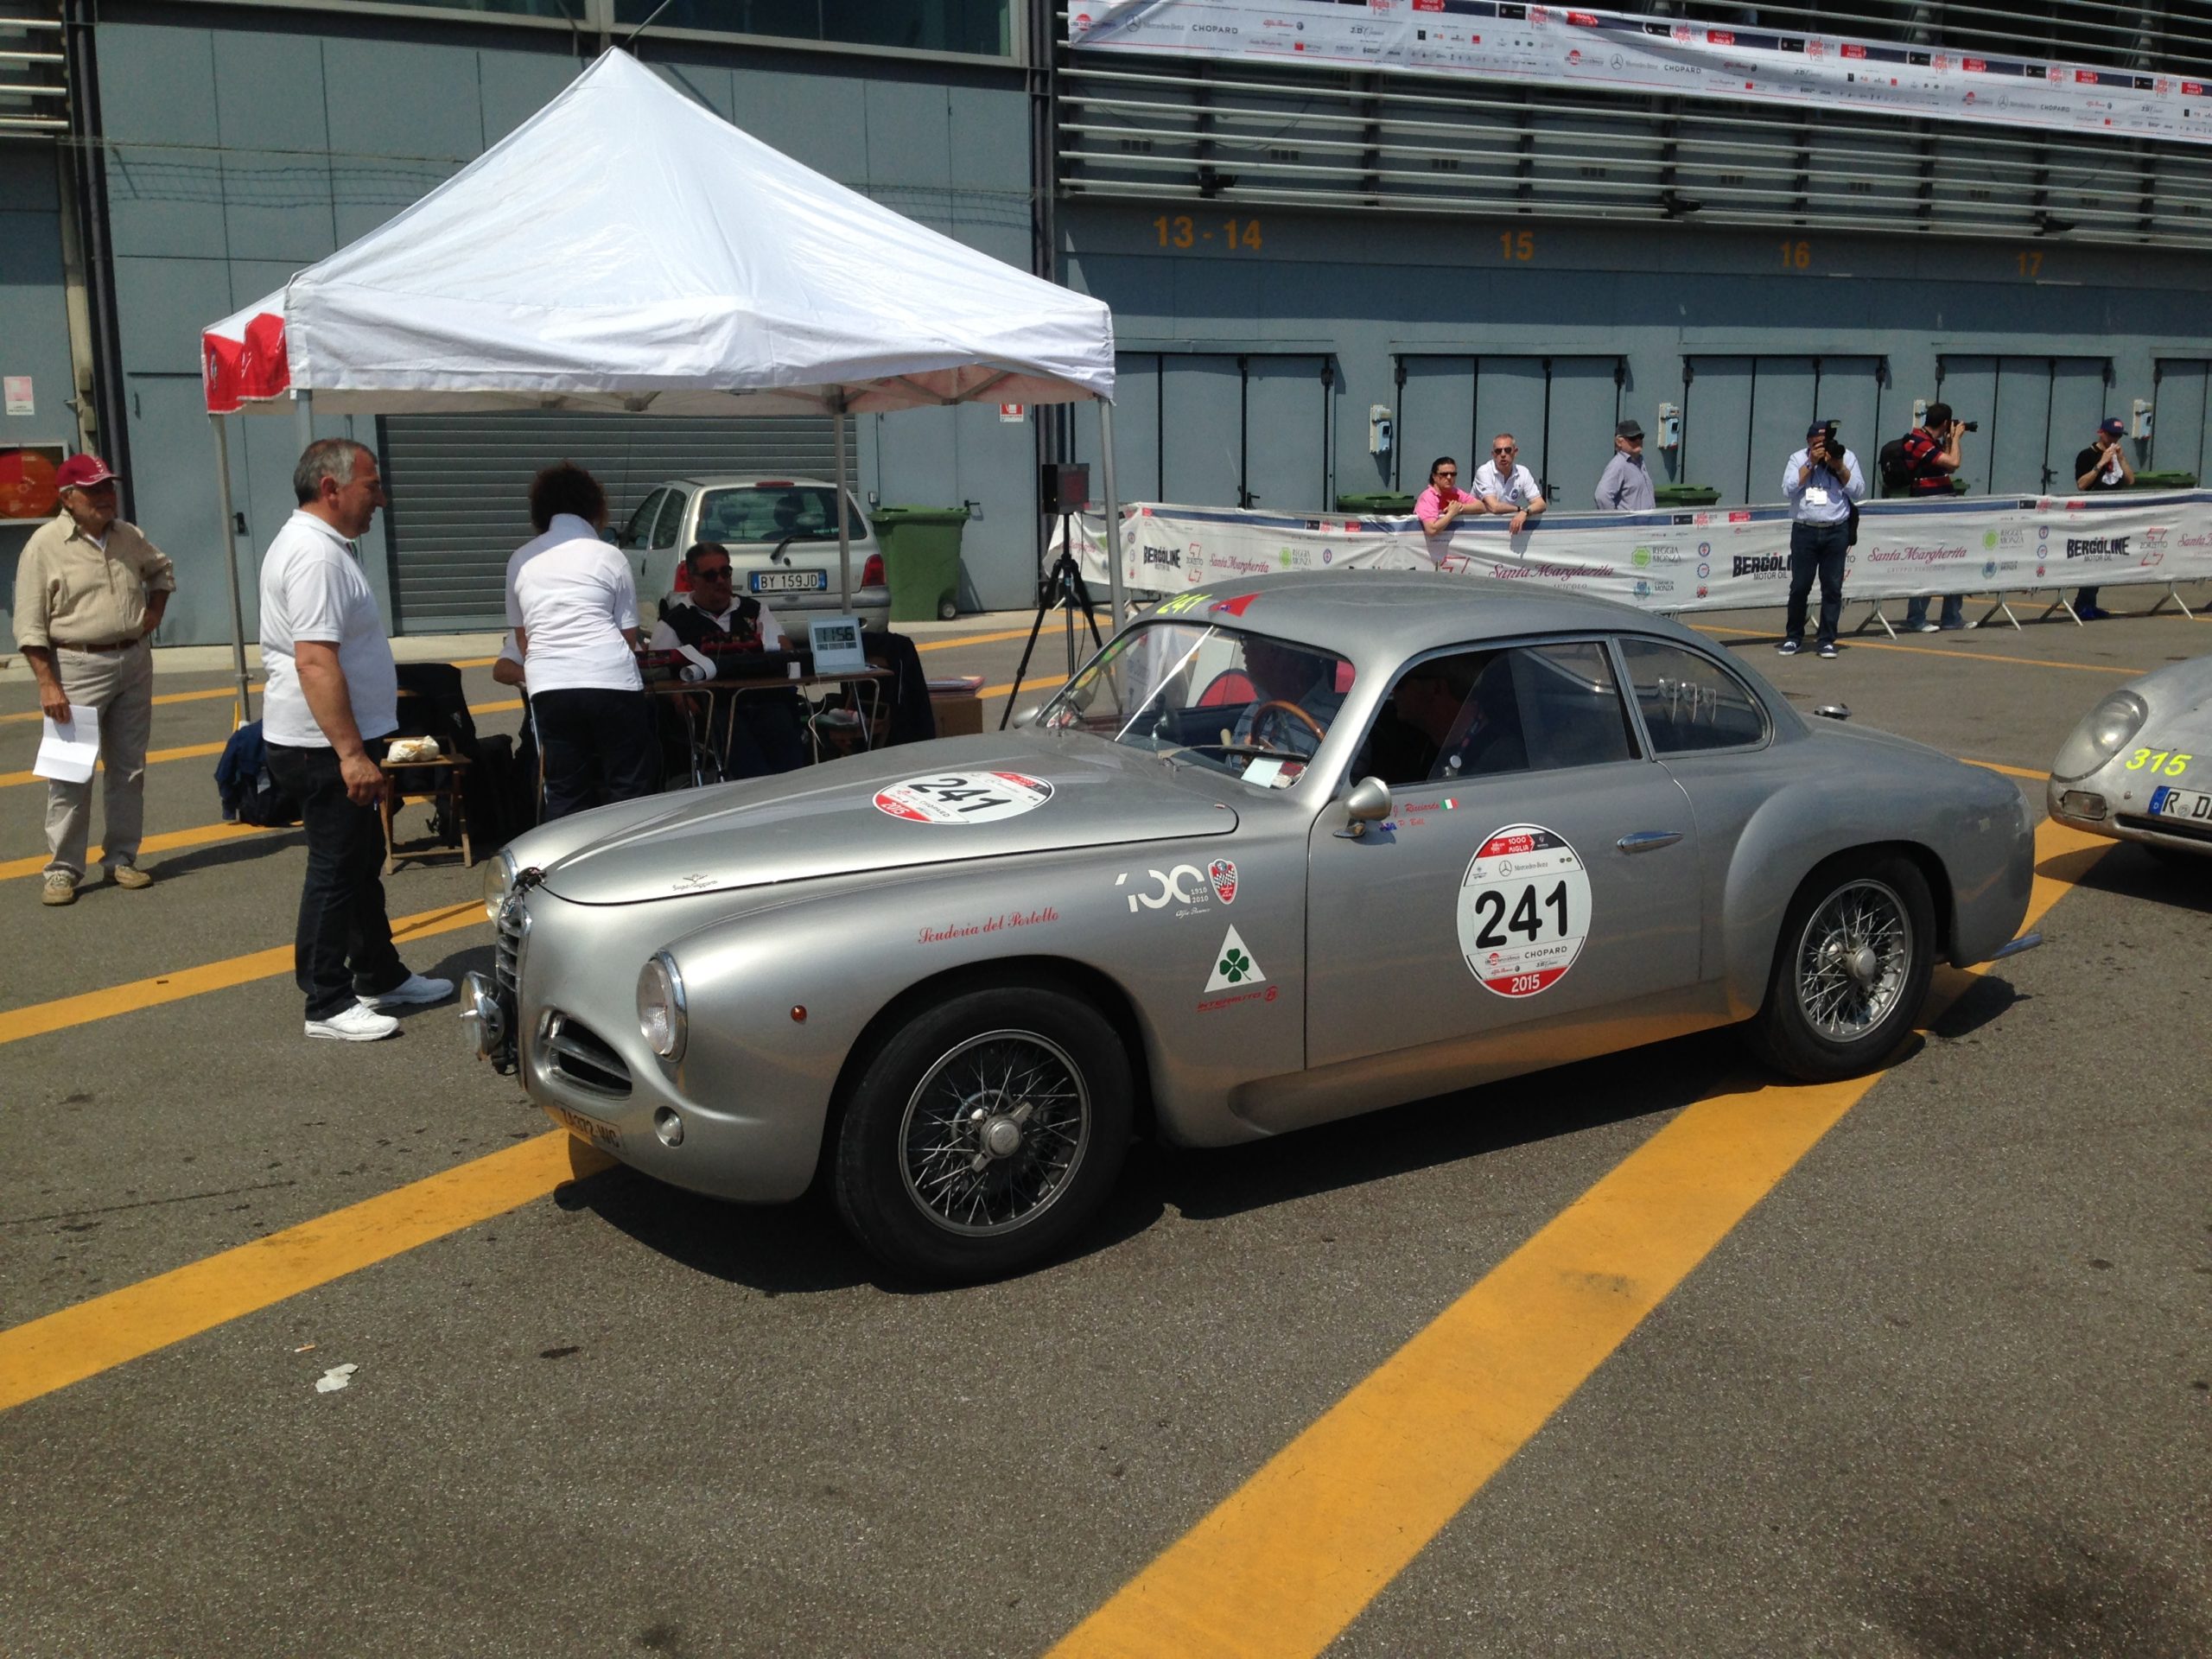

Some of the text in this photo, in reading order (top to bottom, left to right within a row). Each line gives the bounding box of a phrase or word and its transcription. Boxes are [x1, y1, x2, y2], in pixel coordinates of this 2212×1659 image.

[1192, 23, 1239, 35] CHOPARD
[1664, 64, 1702, 74] CHOPARD
[2040, 104, 2070, 113] CHOPARD
[1154, 215, 1194, 248] 13
[1224, 219, 1263, 251] 14
[1500, 231, 1535, 261] 15
[1780, 241, 1811, 269] 16
[2018, 251, 2044, 276] 17
[1868, 546, 1901, 562] Santa
[1900, 545, 1967, 564] Margherita
[760, 574, 817, 588] BY 159JD
[1489, 563, 1614, 581] Santa Margherita
[1754, 571, 1788, 581] MOTOR OIL
[1156, 594, 1213, 614] 241
[2125, 747, 2193, 776] 315
[908, 778, 1012, 812] 241
[2162, 791, 2181, 814] R
[882, 801, 911, 815] 2015
[1508, 844, 1529, 853] MIGLIA
[1191, 887, 1208, 895] 1910
[1192, 895, 1209, 904] 2010
[1475, 880, 1567, 950] 241
[918, 906, 1060, 944] Scuderia del Portello
[1524, 945, 1567, 959] CHOPARD
[1511, 974, 1541, 994] 2015
